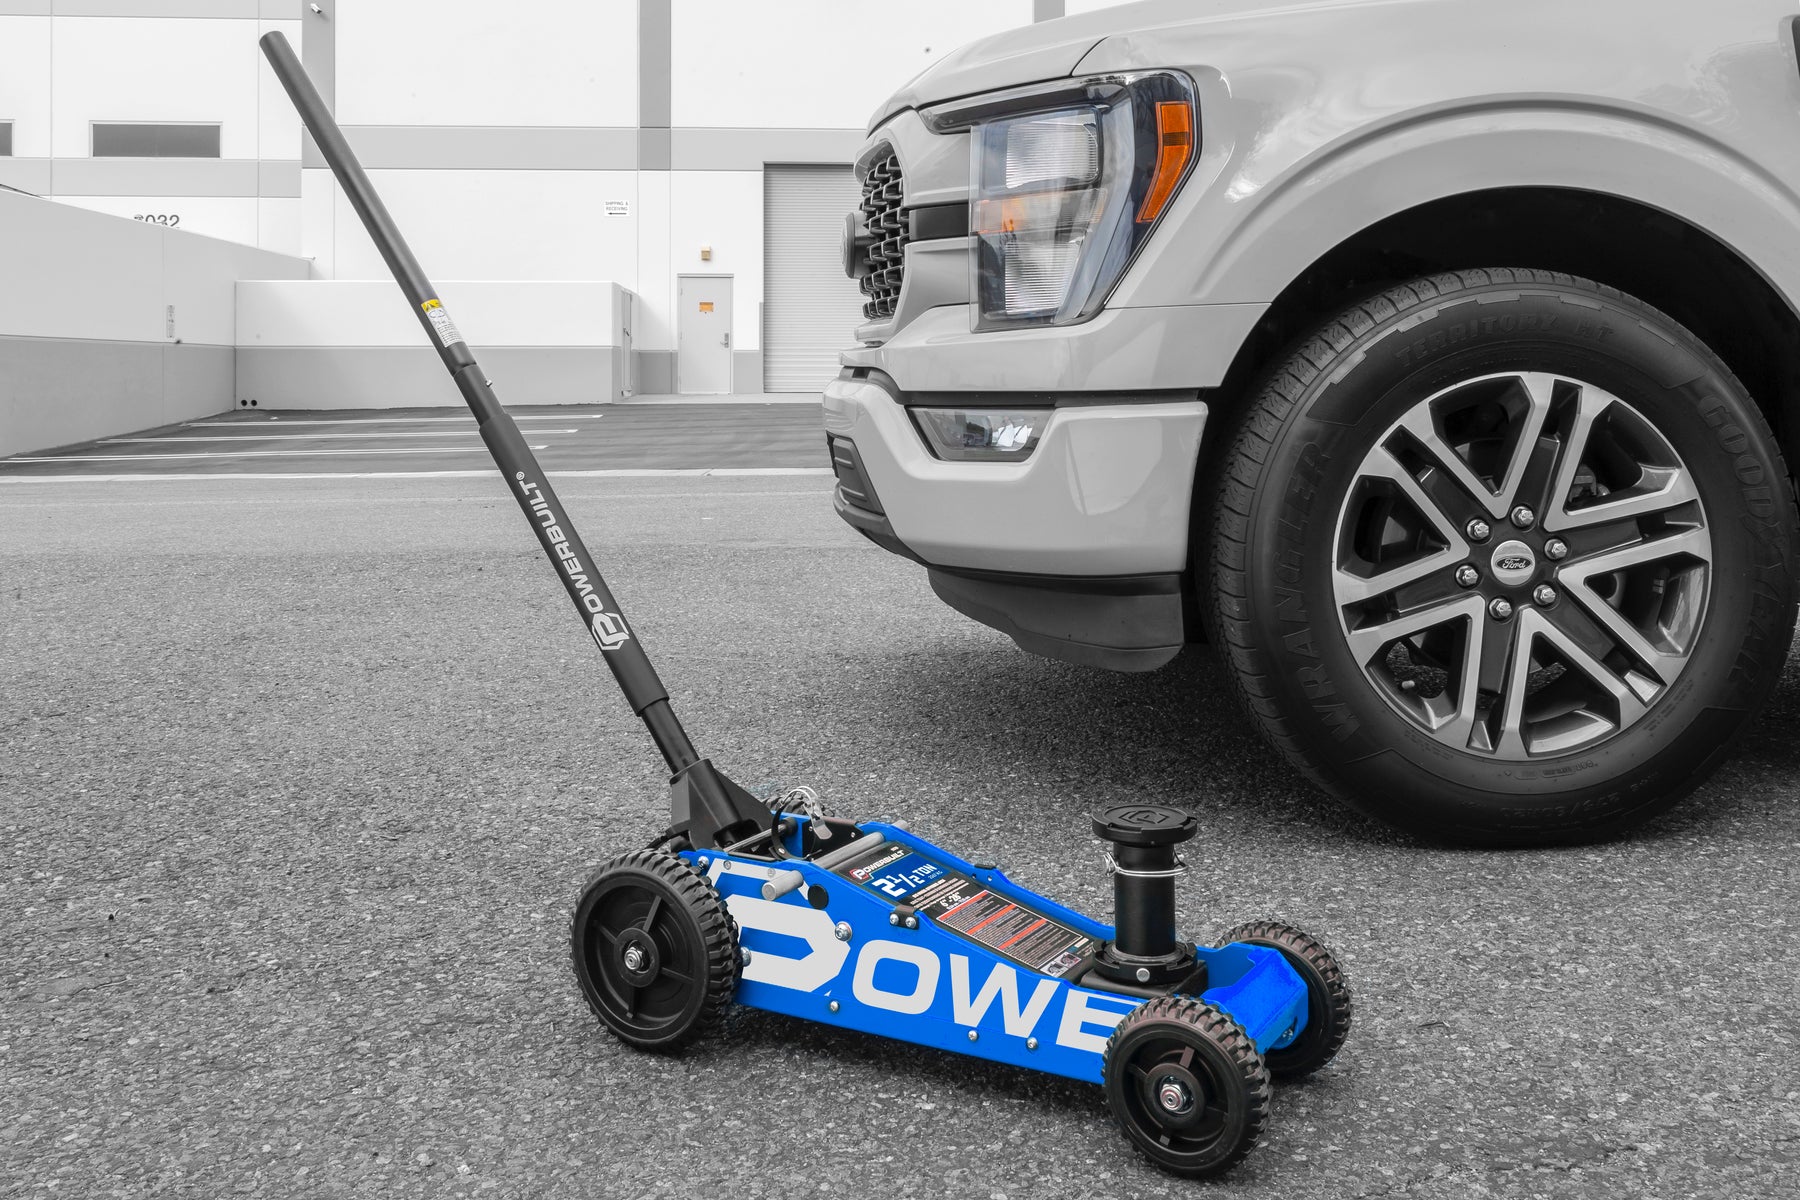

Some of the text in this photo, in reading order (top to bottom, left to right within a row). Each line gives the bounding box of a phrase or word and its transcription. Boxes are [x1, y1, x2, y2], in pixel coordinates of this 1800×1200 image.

[1699, 395, 1786, 690] GOODYEAR
[1502, 557, 1526, 569] Ford
[1272, 441, 1361, 743] WRANGLER
[849, 849, 905, 880] POWERBUILT
[912, 863, 937, 877] TON
